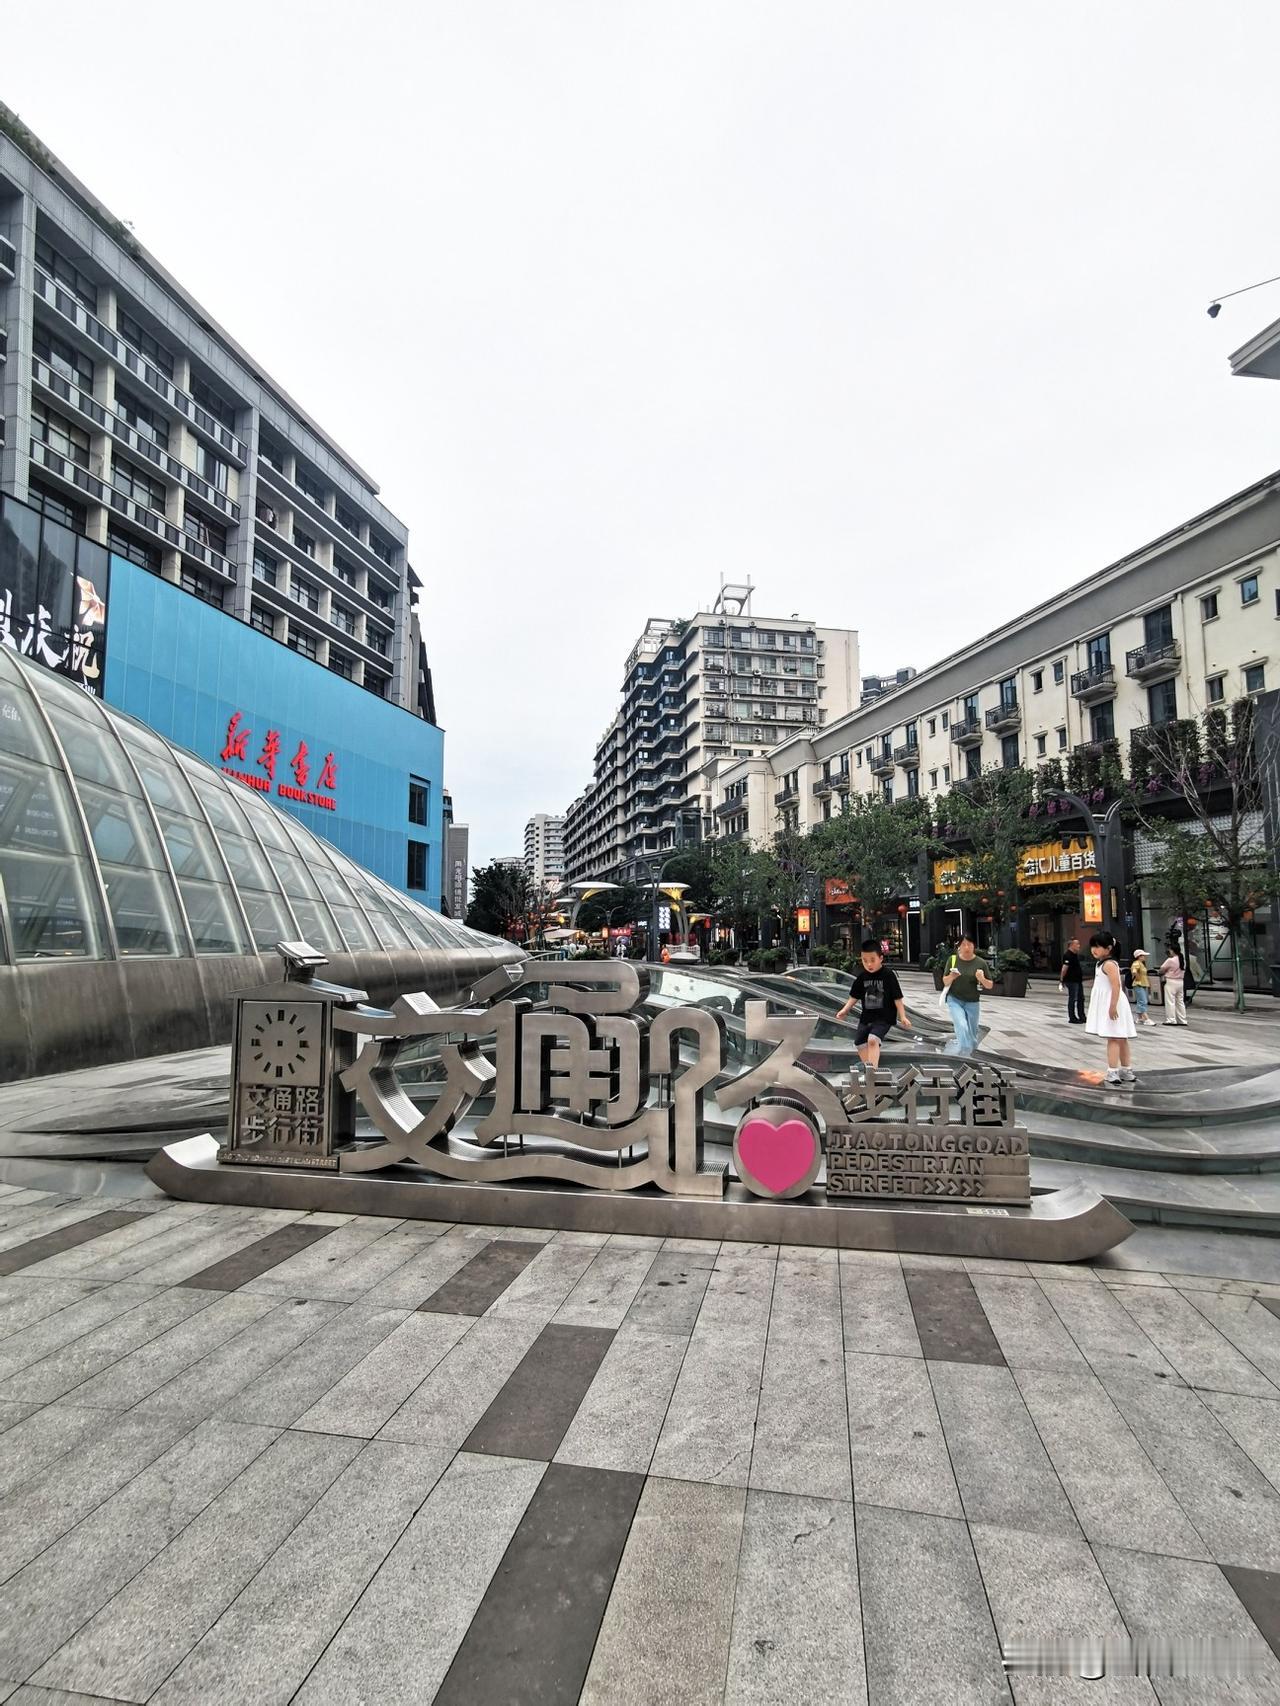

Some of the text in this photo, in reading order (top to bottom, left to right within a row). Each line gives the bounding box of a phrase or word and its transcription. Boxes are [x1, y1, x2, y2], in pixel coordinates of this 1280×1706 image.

[1024, 849, 1097, 877] 金汇儿童百货
[333, 959, 850, 1199] 交通路
[243, 1085, 320, 1116] 交通路
[841, 1063, 1018, 1128] 步行街
[240, 1114, 320, 1147] 步行街
[829, 1152, 985, 1176] PEDESTRIAN
[829, 1174, 920, 1194] STREET
